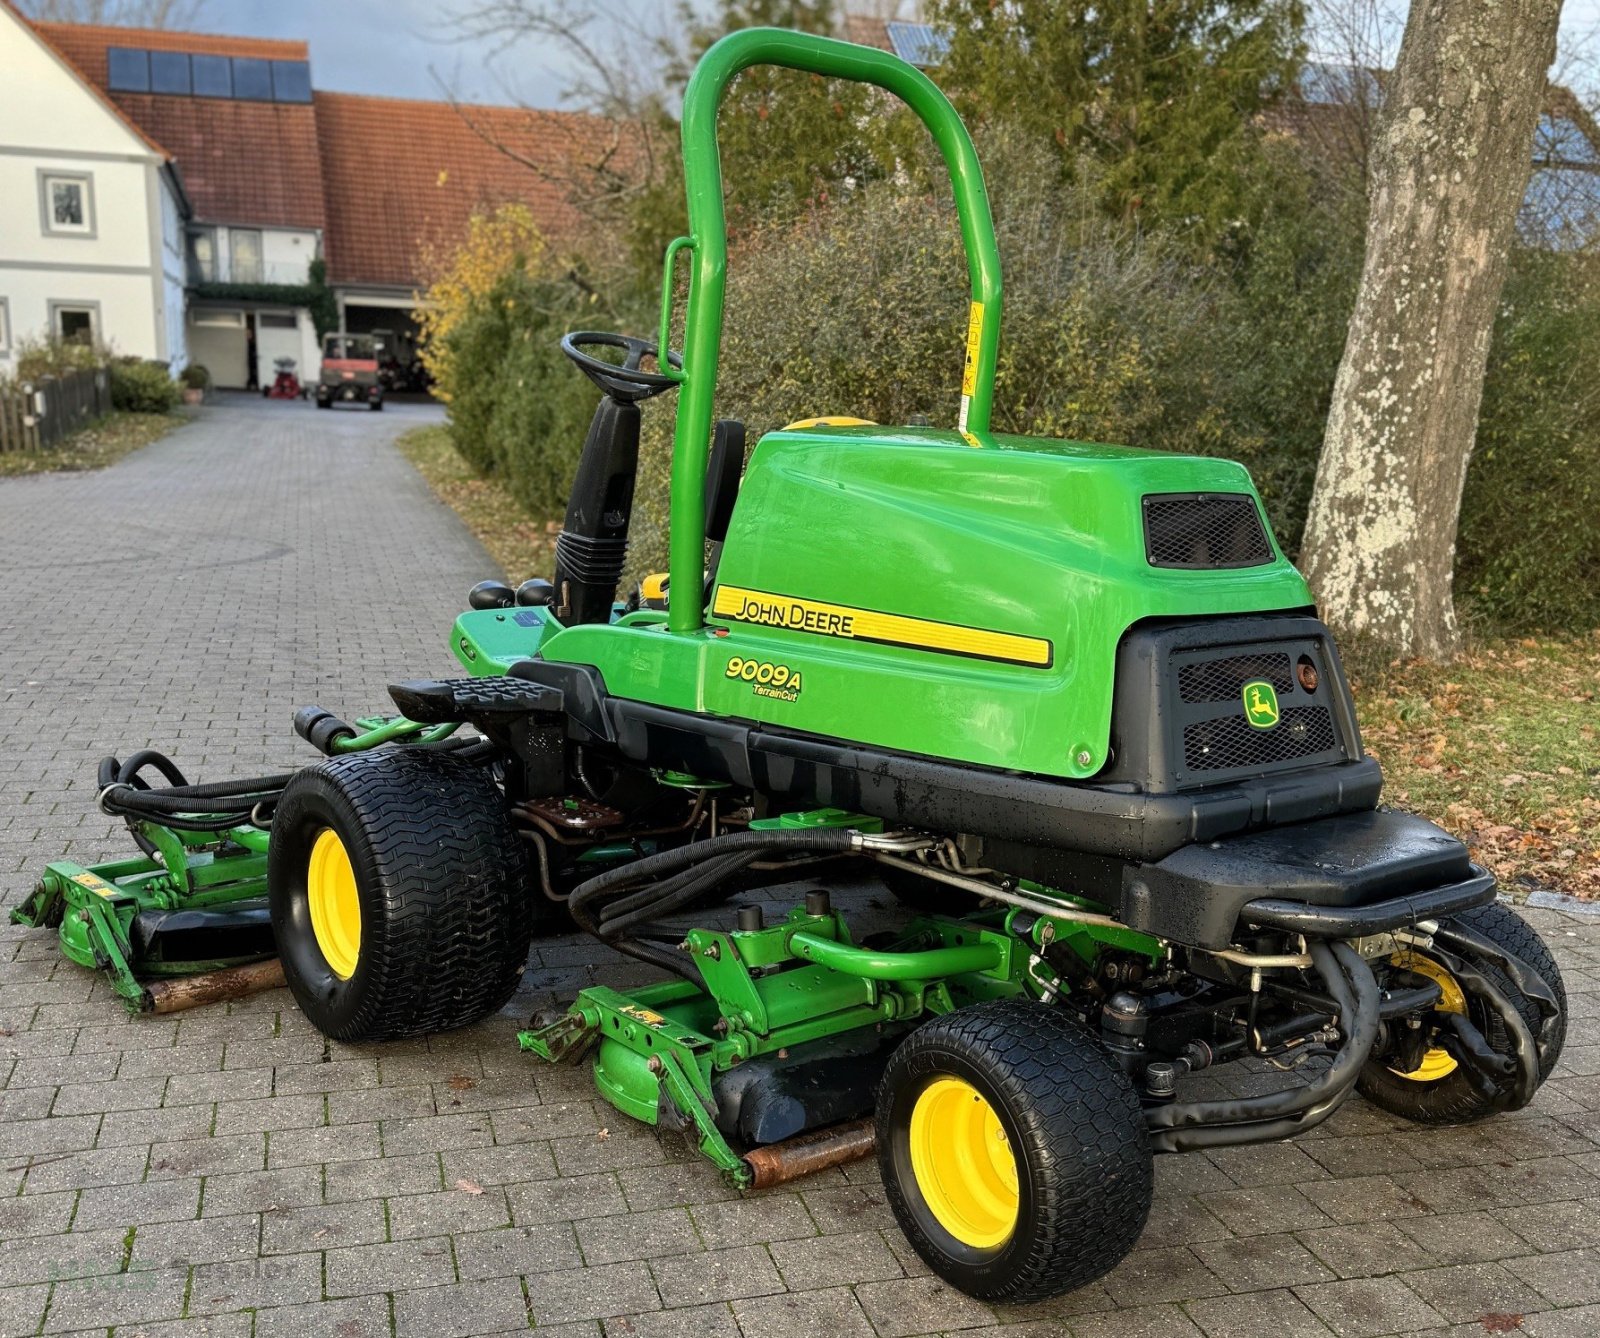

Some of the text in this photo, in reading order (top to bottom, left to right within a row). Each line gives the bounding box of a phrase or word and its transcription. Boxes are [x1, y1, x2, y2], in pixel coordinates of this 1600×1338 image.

[736, 596, 854, 634] JOHN DEERE
[725, 656, 802, 692] 9009A
[752, 683, 798, 702] TerrainCut
